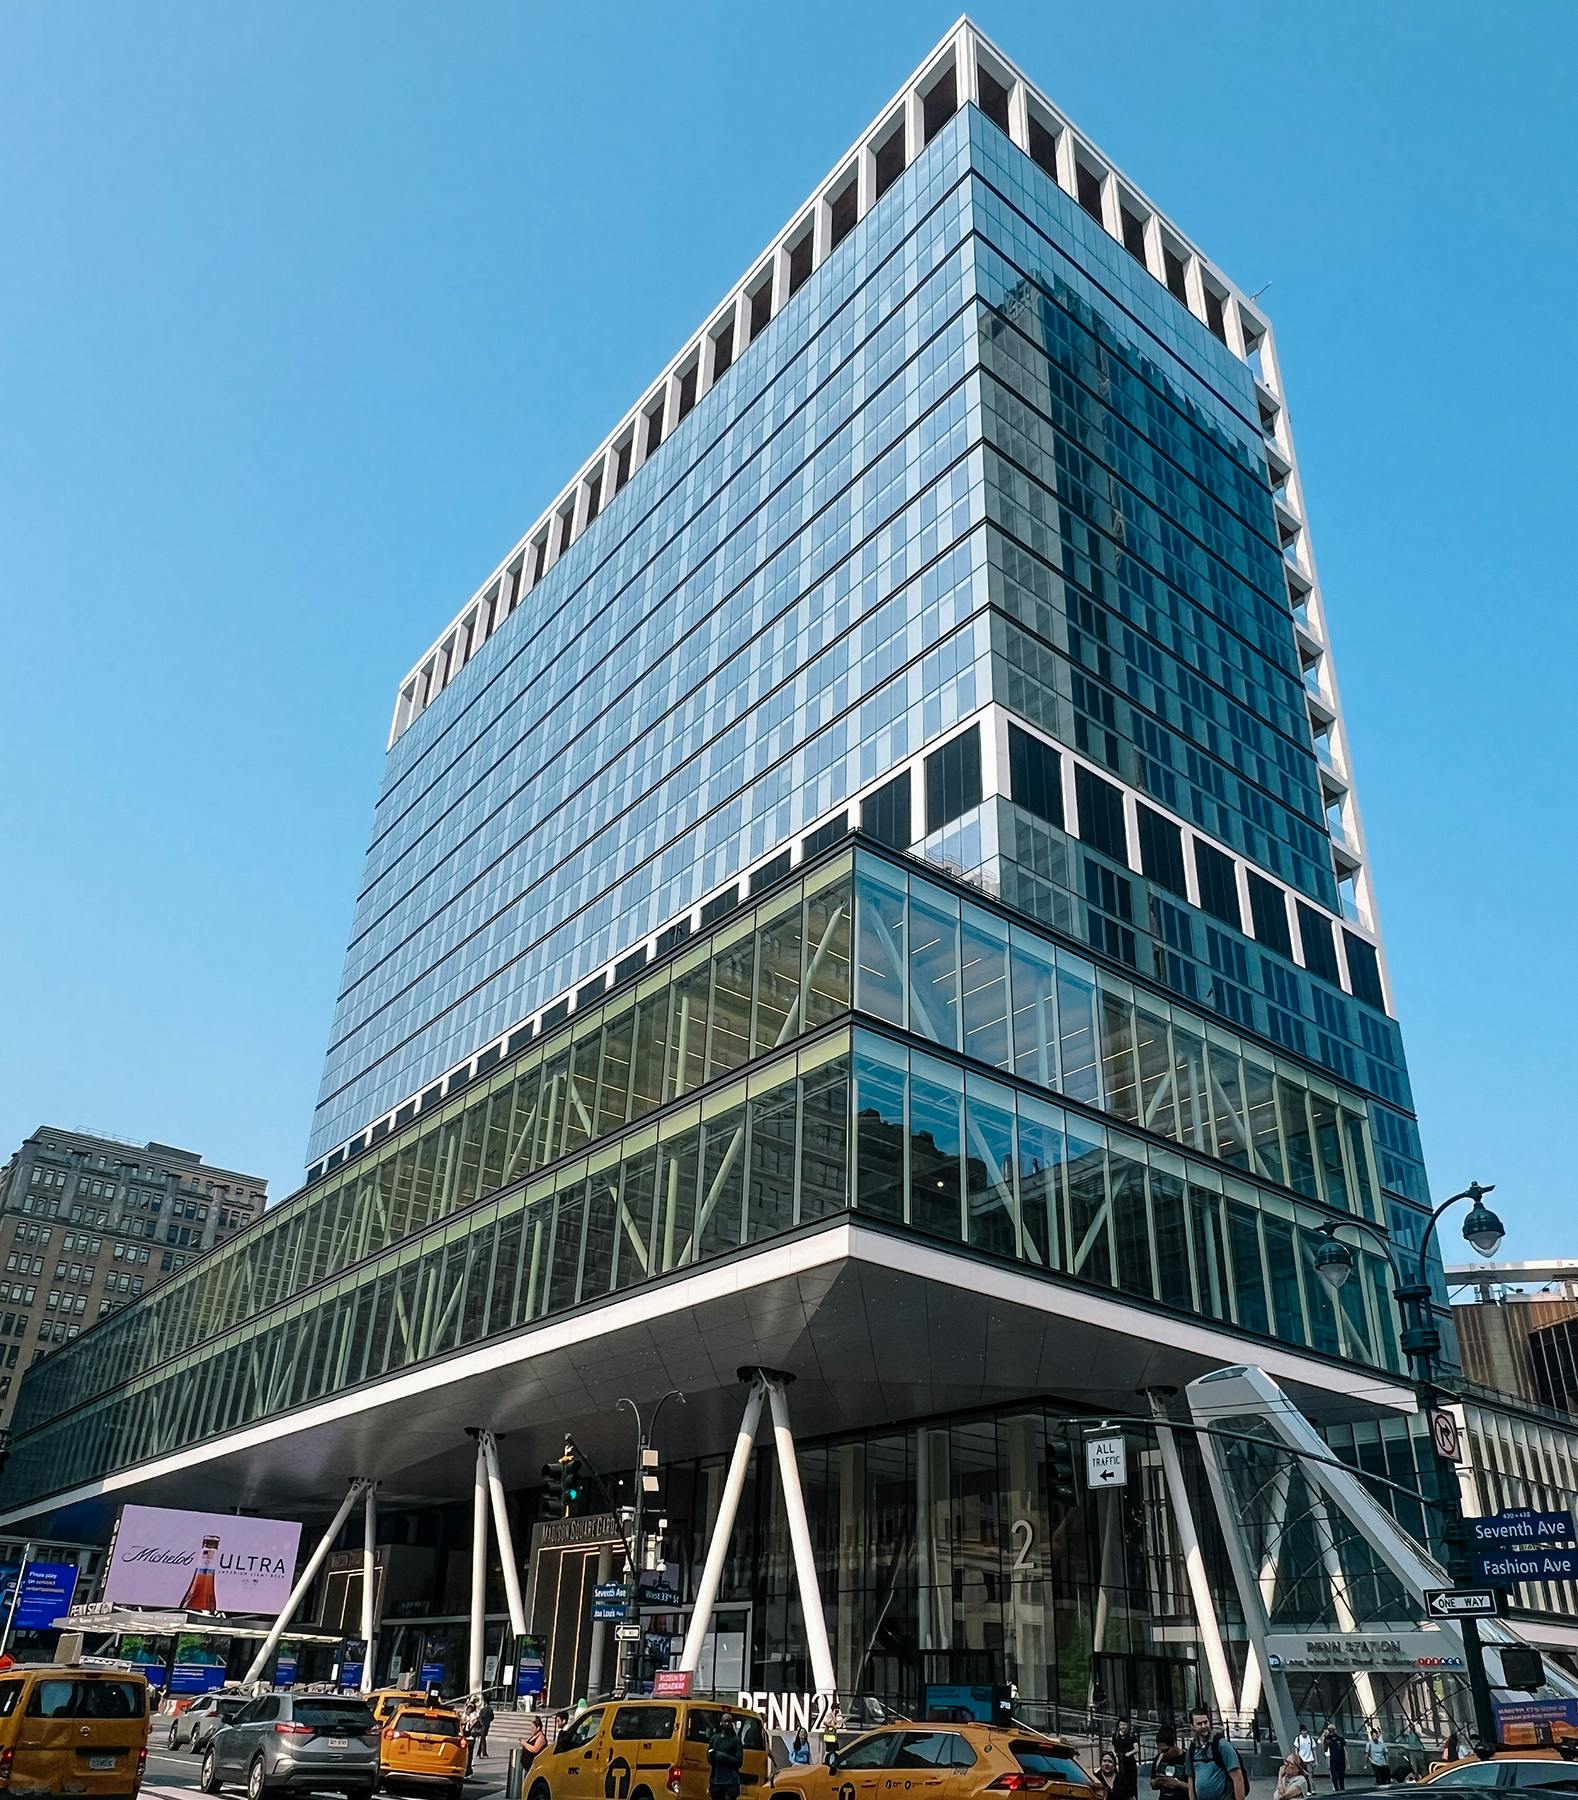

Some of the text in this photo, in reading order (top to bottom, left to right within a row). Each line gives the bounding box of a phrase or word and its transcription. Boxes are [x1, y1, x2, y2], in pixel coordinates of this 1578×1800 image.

[1096, 1443, 1115, 1455] ALL
[1092, 1456, 1121, 1467] TRAFFIC
[570, 1519, 596, 1541] SQUARE
[1475, 1521, 1566, 1539] Seventh Ave
[1011, 1519, 1035, 1570] 2
[121, 1546, 285, 1574] Michelob ULTRA
[1483, 1558, 1572, 1575] Fashion Ave
[594, 1588, 627, 1598] Seventh Ave
[645, 1590, 661, 1601] West
[1438, 1596, 1485, 1609] ONE WAY
[1306, 1641, 1401, 1653] PENN STATION
